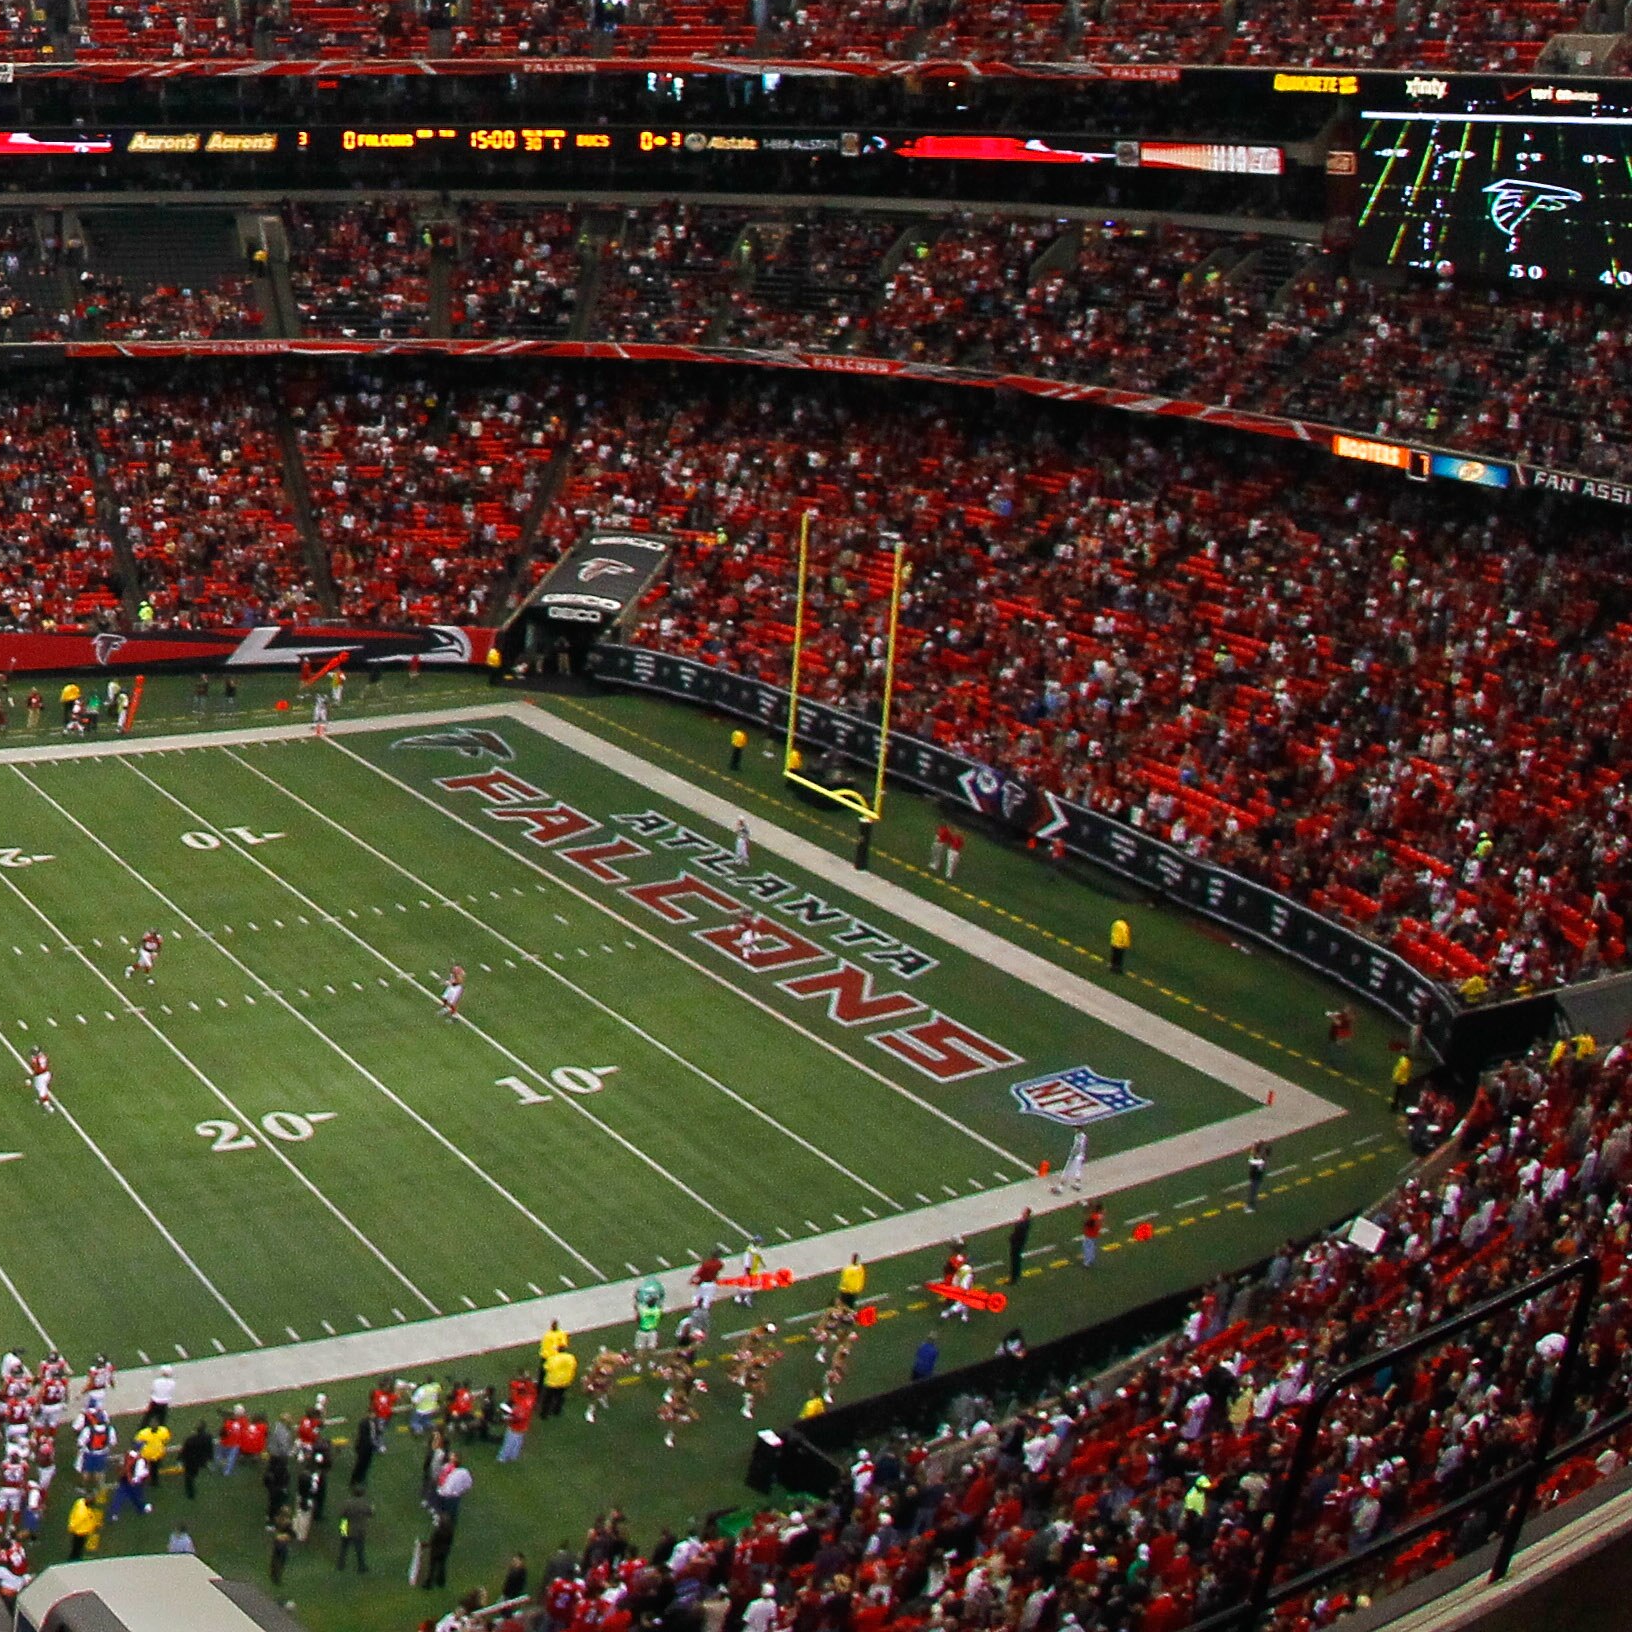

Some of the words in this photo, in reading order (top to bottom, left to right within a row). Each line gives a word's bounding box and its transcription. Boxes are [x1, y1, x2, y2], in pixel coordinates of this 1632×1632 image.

[523, 63, 596, 72] FALCONS
[1111, 67, 1178, 78] FALCONS
[129, 132, 198, 152] Aaron's
[205, 132, 277, 152] Aaron's
[298, 131, 307, 145] 3
[343, 131, 356, 149] 0
[357, 134, 414, 147] FALCONS
[470, 130, 515, 149] 15:00
[576, 134, 610, 147] BUCS
[640, 131, 653, 151] 0
[671, 132, 681, 146] 3
[1510, 264, 1546, 280] 50
[211, 342, 290, 352] FALCONS
[814, 359, 888, 372] FALCONS
[1534, 471, 1575, 493] FAN
[180, 826, 269, 851] 10
[612, 808, 939, 978] ATLANTA
[434, 766, 1025, 1083] FALCONS
[495, 1065, 604, 1106] 10
[1026, 1079, 1099, 1120] NFL
[194, 1111, 314, 1152] 20
